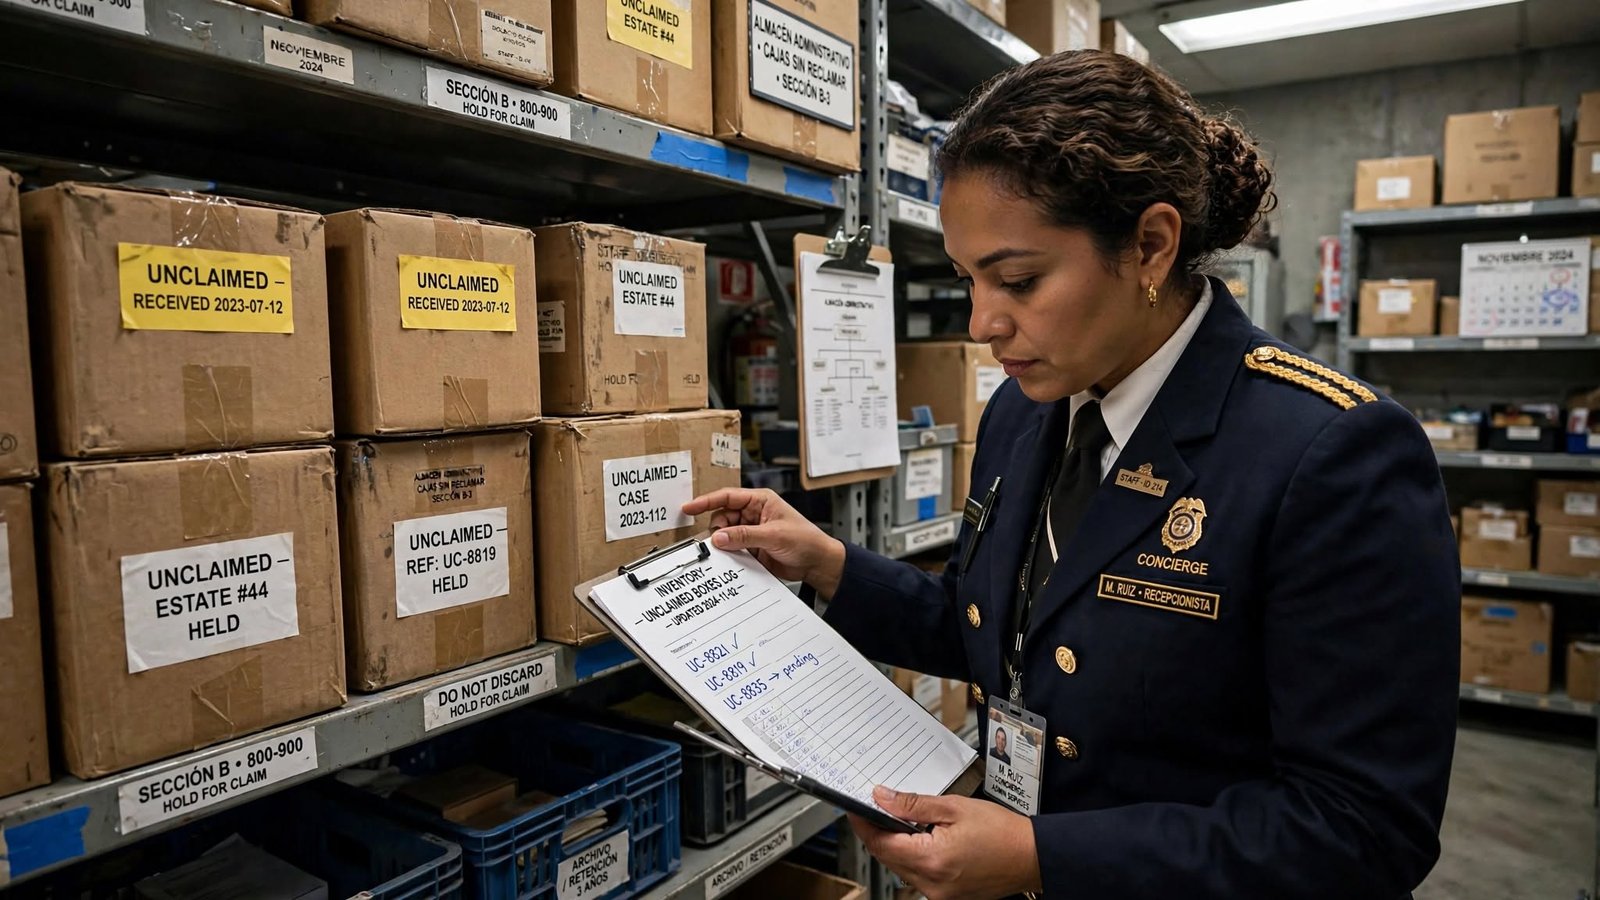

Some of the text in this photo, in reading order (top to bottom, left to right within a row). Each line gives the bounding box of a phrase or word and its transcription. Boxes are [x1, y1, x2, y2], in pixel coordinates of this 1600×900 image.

[624, 14, 658, 38] ESTATE
[754, 15, 850, 69] ALMACÉN ADMINISTRATIVO
[300, 60, 323, 73] 2024
[764, 42, 790, 67] CAJAS
[792, 54, 805, 73] SIN
[808, 61, 846, 90] RECLAMAR
[446, 79, 498, 106] SECCIÓN
[502, 94, 509, 108] B
[520, 100, 558, 121] 800-900
[782, 74, 817, 100] SECCIÓN
[820, 88, 830, 105] B-3
[463, 102, 535, 129] HOLD FOR CLAIM
[148, 264, 269, 290] UNCLAIMED
[417, 272, 499, 293] UNCLAIMED
[619, 270, 678, 289] UNCLAIMED
[133, 293, 283, 314] RECEIVED 2023-07-12
[408, 296, 510, 314] RECEIVED 2023-07-12
[623, 291, 675, 308] ESTATE #44
[604, 374, 626, 385] HOLD
[612, 465, 678, 487] UNCLAIMED
[1120, 474, 1140, 485] STAFF
[1144, 480, 1150, 488] ID
[1151, 482, 1162, 491] 214
[618, 489, 650, 507] CASE
[620, 506, 666, 528] 2023-112
[410, 523, 493, 550] UNCLAIMED
[148, 552, 272, 590] UNCLAIMED
[407, 546, 496, 576] REF: UC-8819
[1137, 553, 1208, 575] CONCIERGE
[432, 573, 468, 594] HELD
[642, 591, 694, 622] UNCLAIMED
[691, 578, 722, 598] BOXES
[718, 570, 738, 585] LOG
[654, 567, 706, 598] INVENTORY
[156, 580, 269, 618] ESTATE #44
[1105, 581, 1114, 594] M.
[1117, 582, 1136, 597] RUIZ
[1144, 588, 1210, 612] RECEPCIONISTA
[188, 614, 240, 641] HELD
[670, 604, 704, 626] UPDATED
[685, 644, 730, 672] UC-8821
[438, 662, 542, 706] DO NOT DISCARD
[704, 660, 748, 692] UC-8819
[722, 652, 820, 710] UC-8835 pending
[450, 683, 530, 718] HOLD FOR CLAIM
[138, 764, 214, 804] SECCIÓN
[219, 760, 230, 778] B
[247, 736, 304, 768] 800-900
[163, 768, 267, 814] HOLD FOR CLAIM
[569, 852, 618, 888] RETENCIÓN
[572, 844, 610, 872] ARCHIVO
[712, 860, 744, 888] ARCHIVO
[750, 832, 788, 864] RETENCIÓN
[577, 871, 608, 896] 3 AÑOS
